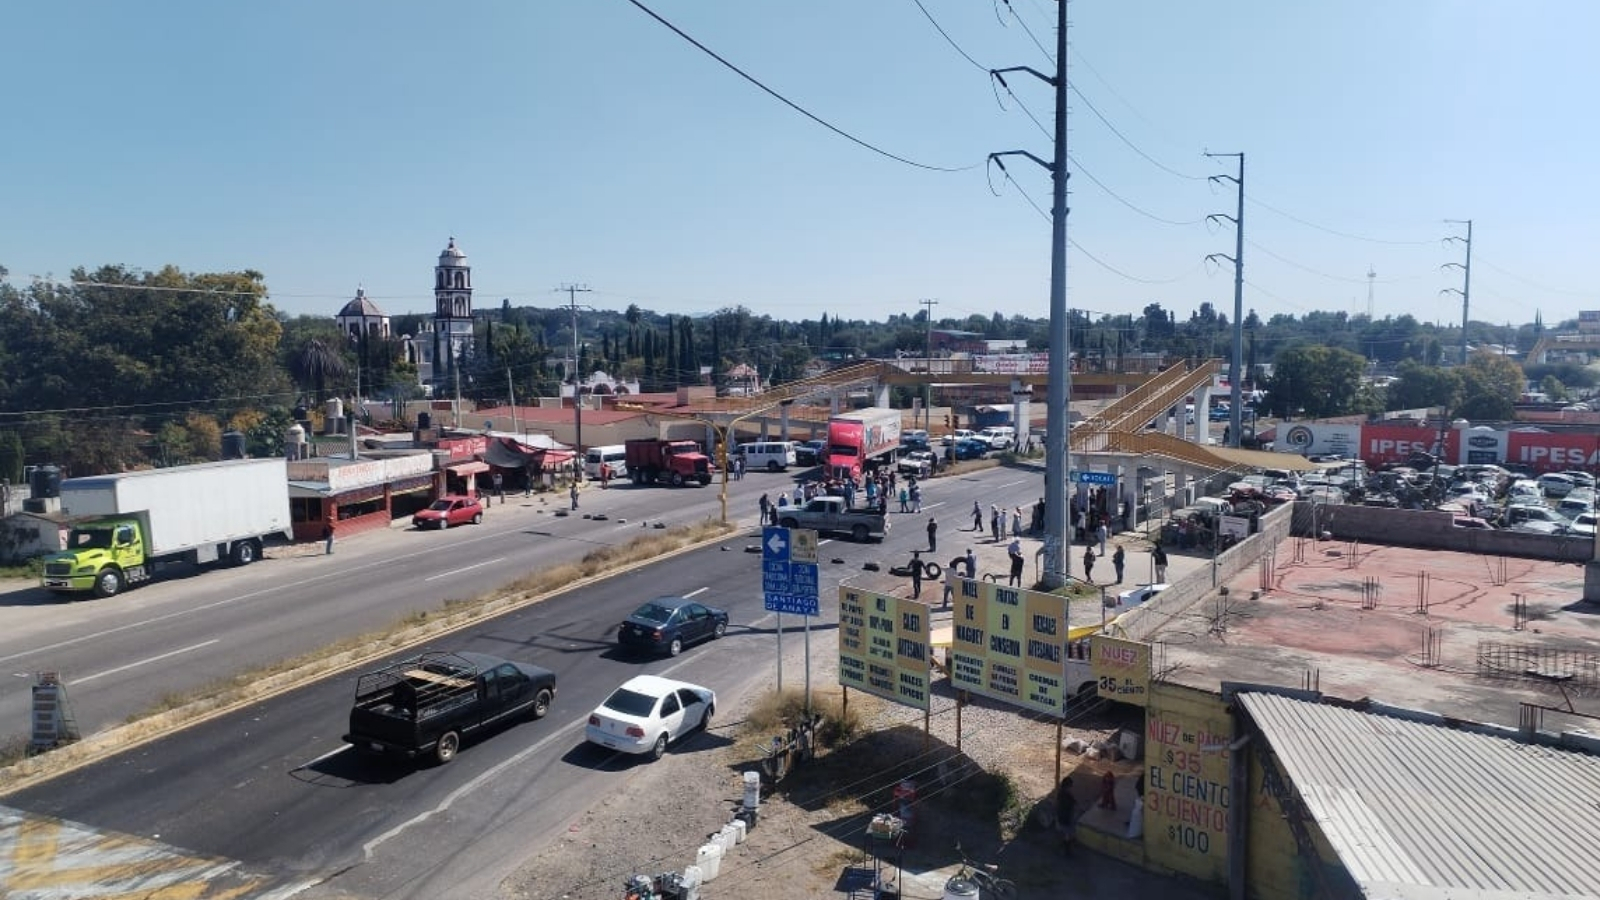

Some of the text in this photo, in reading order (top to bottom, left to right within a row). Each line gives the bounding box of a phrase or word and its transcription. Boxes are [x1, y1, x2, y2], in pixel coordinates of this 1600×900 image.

[766, 595, 816, 606] SANTIAGO
[956, 625, 984, 645] MAGUEY
[1101, 644, 1138, 663] NUEZ
[1100, 676, 1117, 693] 35
[1149, 720, 1181, 747] NUEZ
[1182, 733, 1195, 744] DE
[1150, 766, 1166, 790] EL
[1172, 773, 1230, 809] CIENTO
